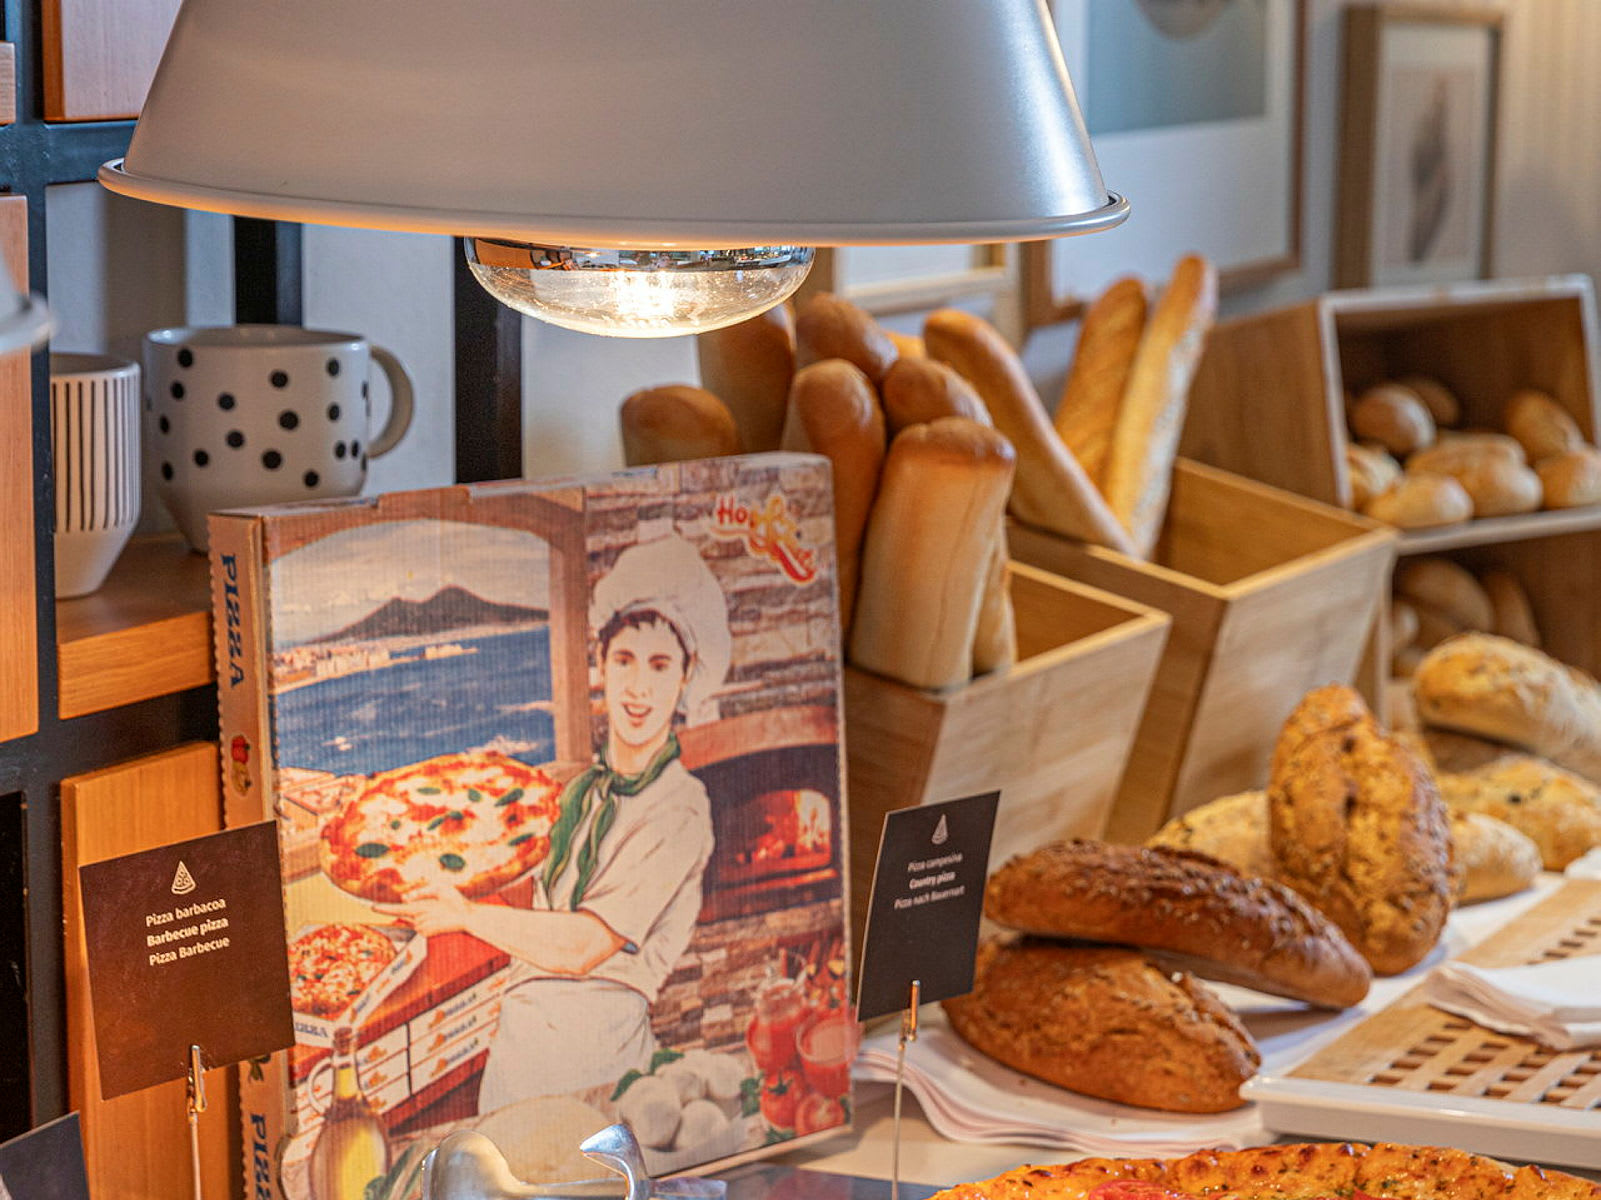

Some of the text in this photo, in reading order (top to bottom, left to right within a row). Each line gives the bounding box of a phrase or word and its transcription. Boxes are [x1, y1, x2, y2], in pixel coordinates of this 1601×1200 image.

[220, 554, 245, 689] PIZZA
[908, 861, 926, 873] Pizza
[145, 898, 226, 927] Pizza barbacoa
[894, 897, 913, 911] Pizza
[146, 917, 229, 947] Barbecue pizza
[149, 937, 230, 966] Pizza Barbecue
